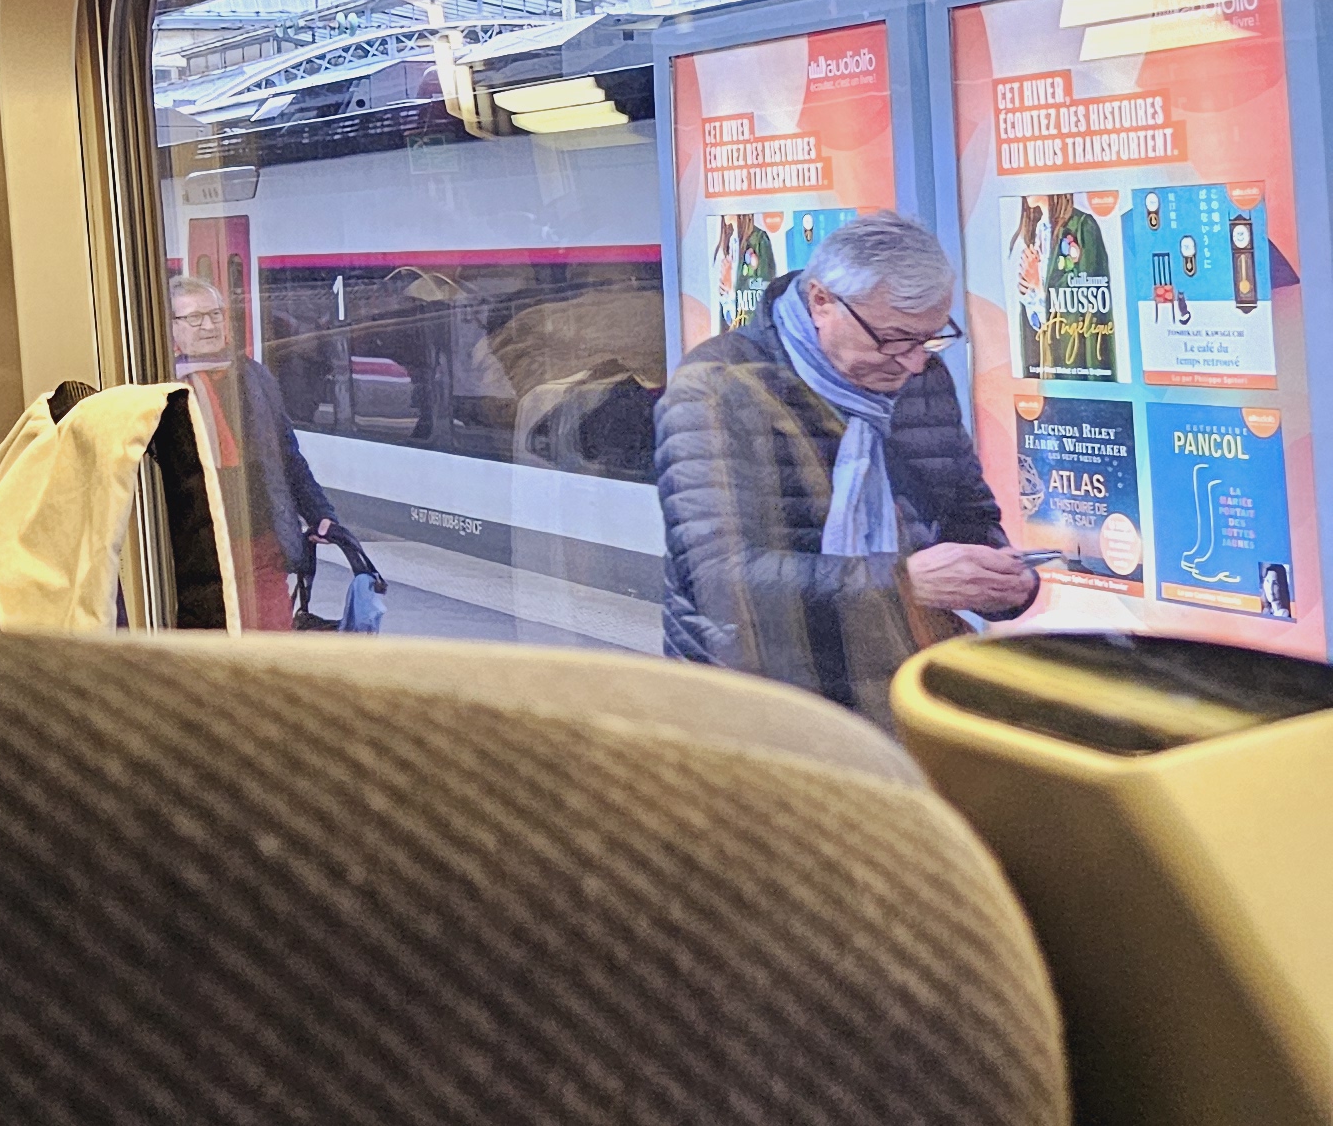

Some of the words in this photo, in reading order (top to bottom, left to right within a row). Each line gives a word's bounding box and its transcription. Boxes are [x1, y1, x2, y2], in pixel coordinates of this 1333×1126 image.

[826, 48, 876, 77] audiolib
[997, 82, 1020, 110] CET
[1023, 77, 1071, 106] HIVER,
[705, 122, 721, 144] CET
[722, 119, 754, 143] HIVER,
[999, 108, 1058, 139] ÉCOUTEZ
[1060, 104, 1087, 134] DES
[1089, 96, 1164, 131] HISTOIRES
[706, 143, 745, 168] ÉCOUTEZ
[746, 142, 764, 165] DES
[764, 136, 817, 163] HISTOIRES
[1001, 142, 1025, 169] QUI
[1026, 138, 1063, 167] VOUS
[1065, 128, 1179, 164] TRANSPORTENT.
[707, 171, 723, 193] QUI
[724, 169, 748, 192] VOUS
[749, 163, 829, 190] TRANSPORTENT.
[333, 275, 345, 320] 1
[1049, 287, 1110, 313] MUSSO
[1035, 311, 1115, 365] Angélique
[1183, 341, 1195, 353] Le
[1197, 341, 1214, 353] café
[1217, 342, 1229, 354] du
[1176, 357, 1201, 368] temps
[1203, 356, 1240, 367] retrouvé
[1033, 420, 1079, 438] LUCINDA
[1082, 423, 1116, 440] RILEY
[1024, 434, 1060, 451] HARRY
[1062, 437, 1128, 457] WHITTAKER
[1173, 430, 1250, 460] PANCOL
[1048, 469, 1107, 498] ATLAS
[1049, 497, 1094, 514] L'HISTOIRE
[1095, 502, 1108, 515] DE
[1075, 514, 1097, 527] SALT
